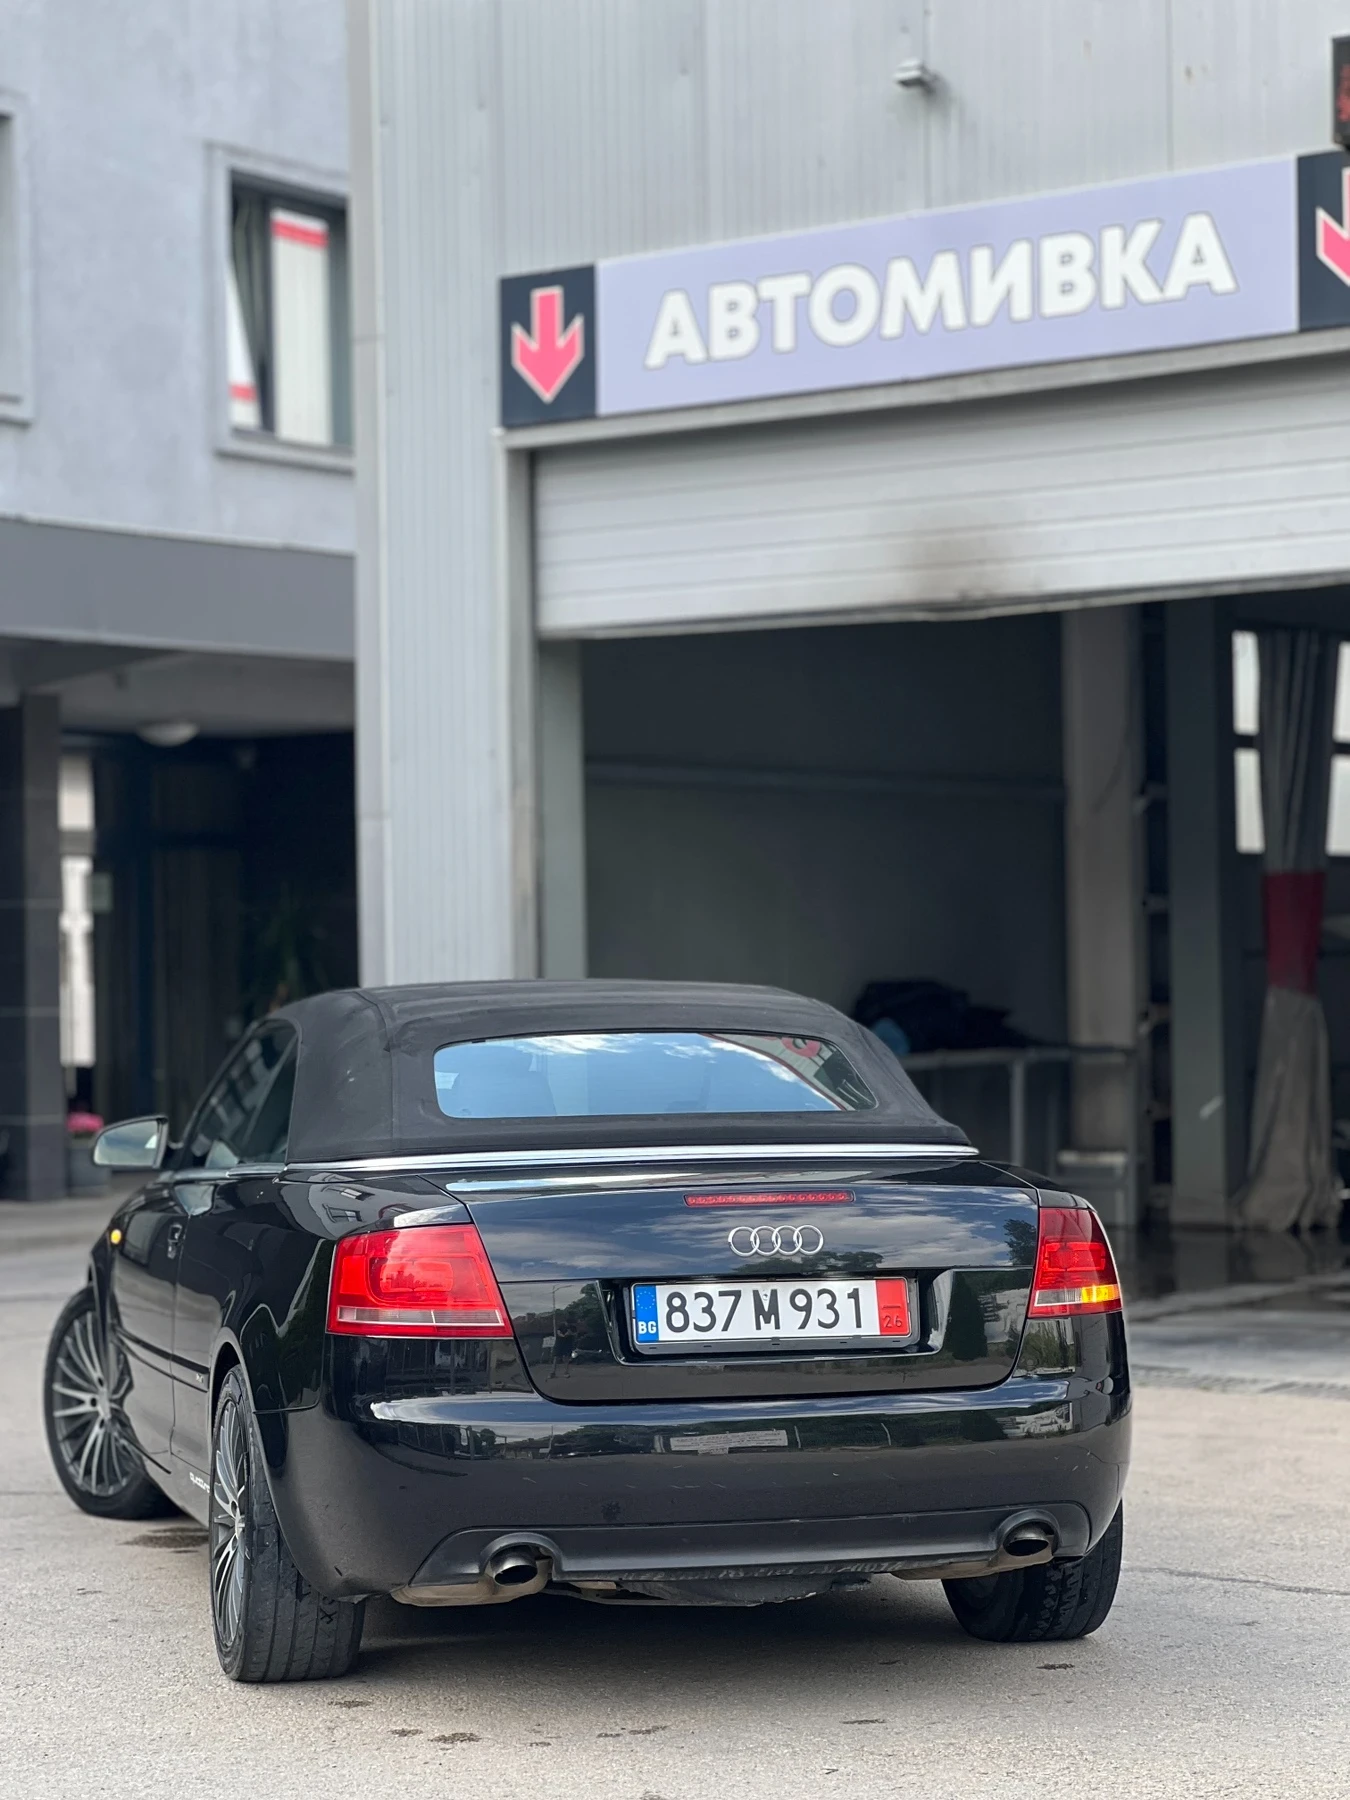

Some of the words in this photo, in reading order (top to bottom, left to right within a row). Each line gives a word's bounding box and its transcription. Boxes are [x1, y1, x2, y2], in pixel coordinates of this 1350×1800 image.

[644, 212, 1238, 370] АВТОМИВКА
[666, 1291, 742, 1333] 837
[753, 1289, 780, 1330] M
[789, 1288, 862, 1329] 931
[883, 1314, 903, 1329] 26
[638, 1320, 657, 1334] BG
